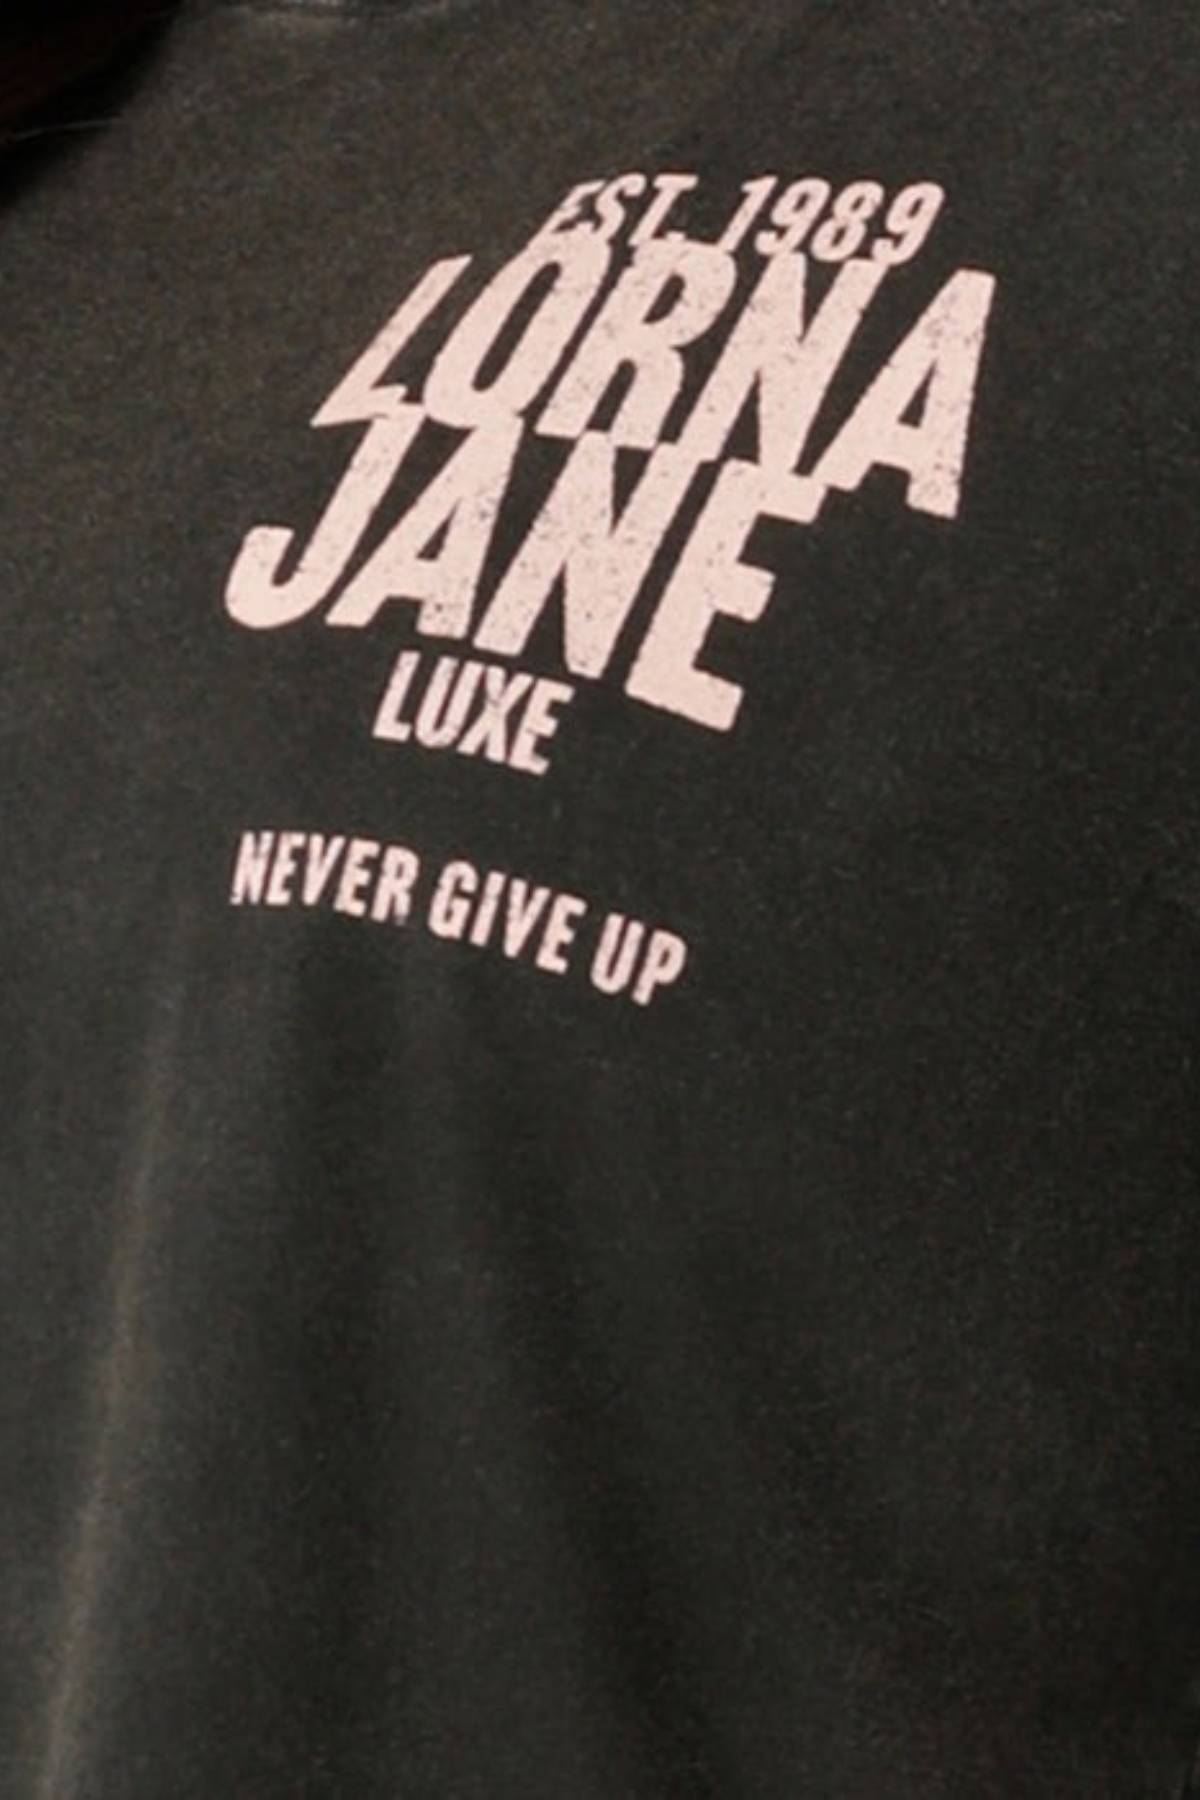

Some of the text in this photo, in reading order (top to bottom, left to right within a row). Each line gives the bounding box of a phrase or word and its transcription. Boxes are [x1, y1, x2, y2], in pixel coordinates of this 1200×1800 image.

[717, 175, 946, 266] 1989
[311, 229, 997, 520] LORNA
[224, 402, 828, 732] JANE
[372, 651, 575, 775] LUXE
[230, 830, 687, 1006] NEVER GIVE UP
